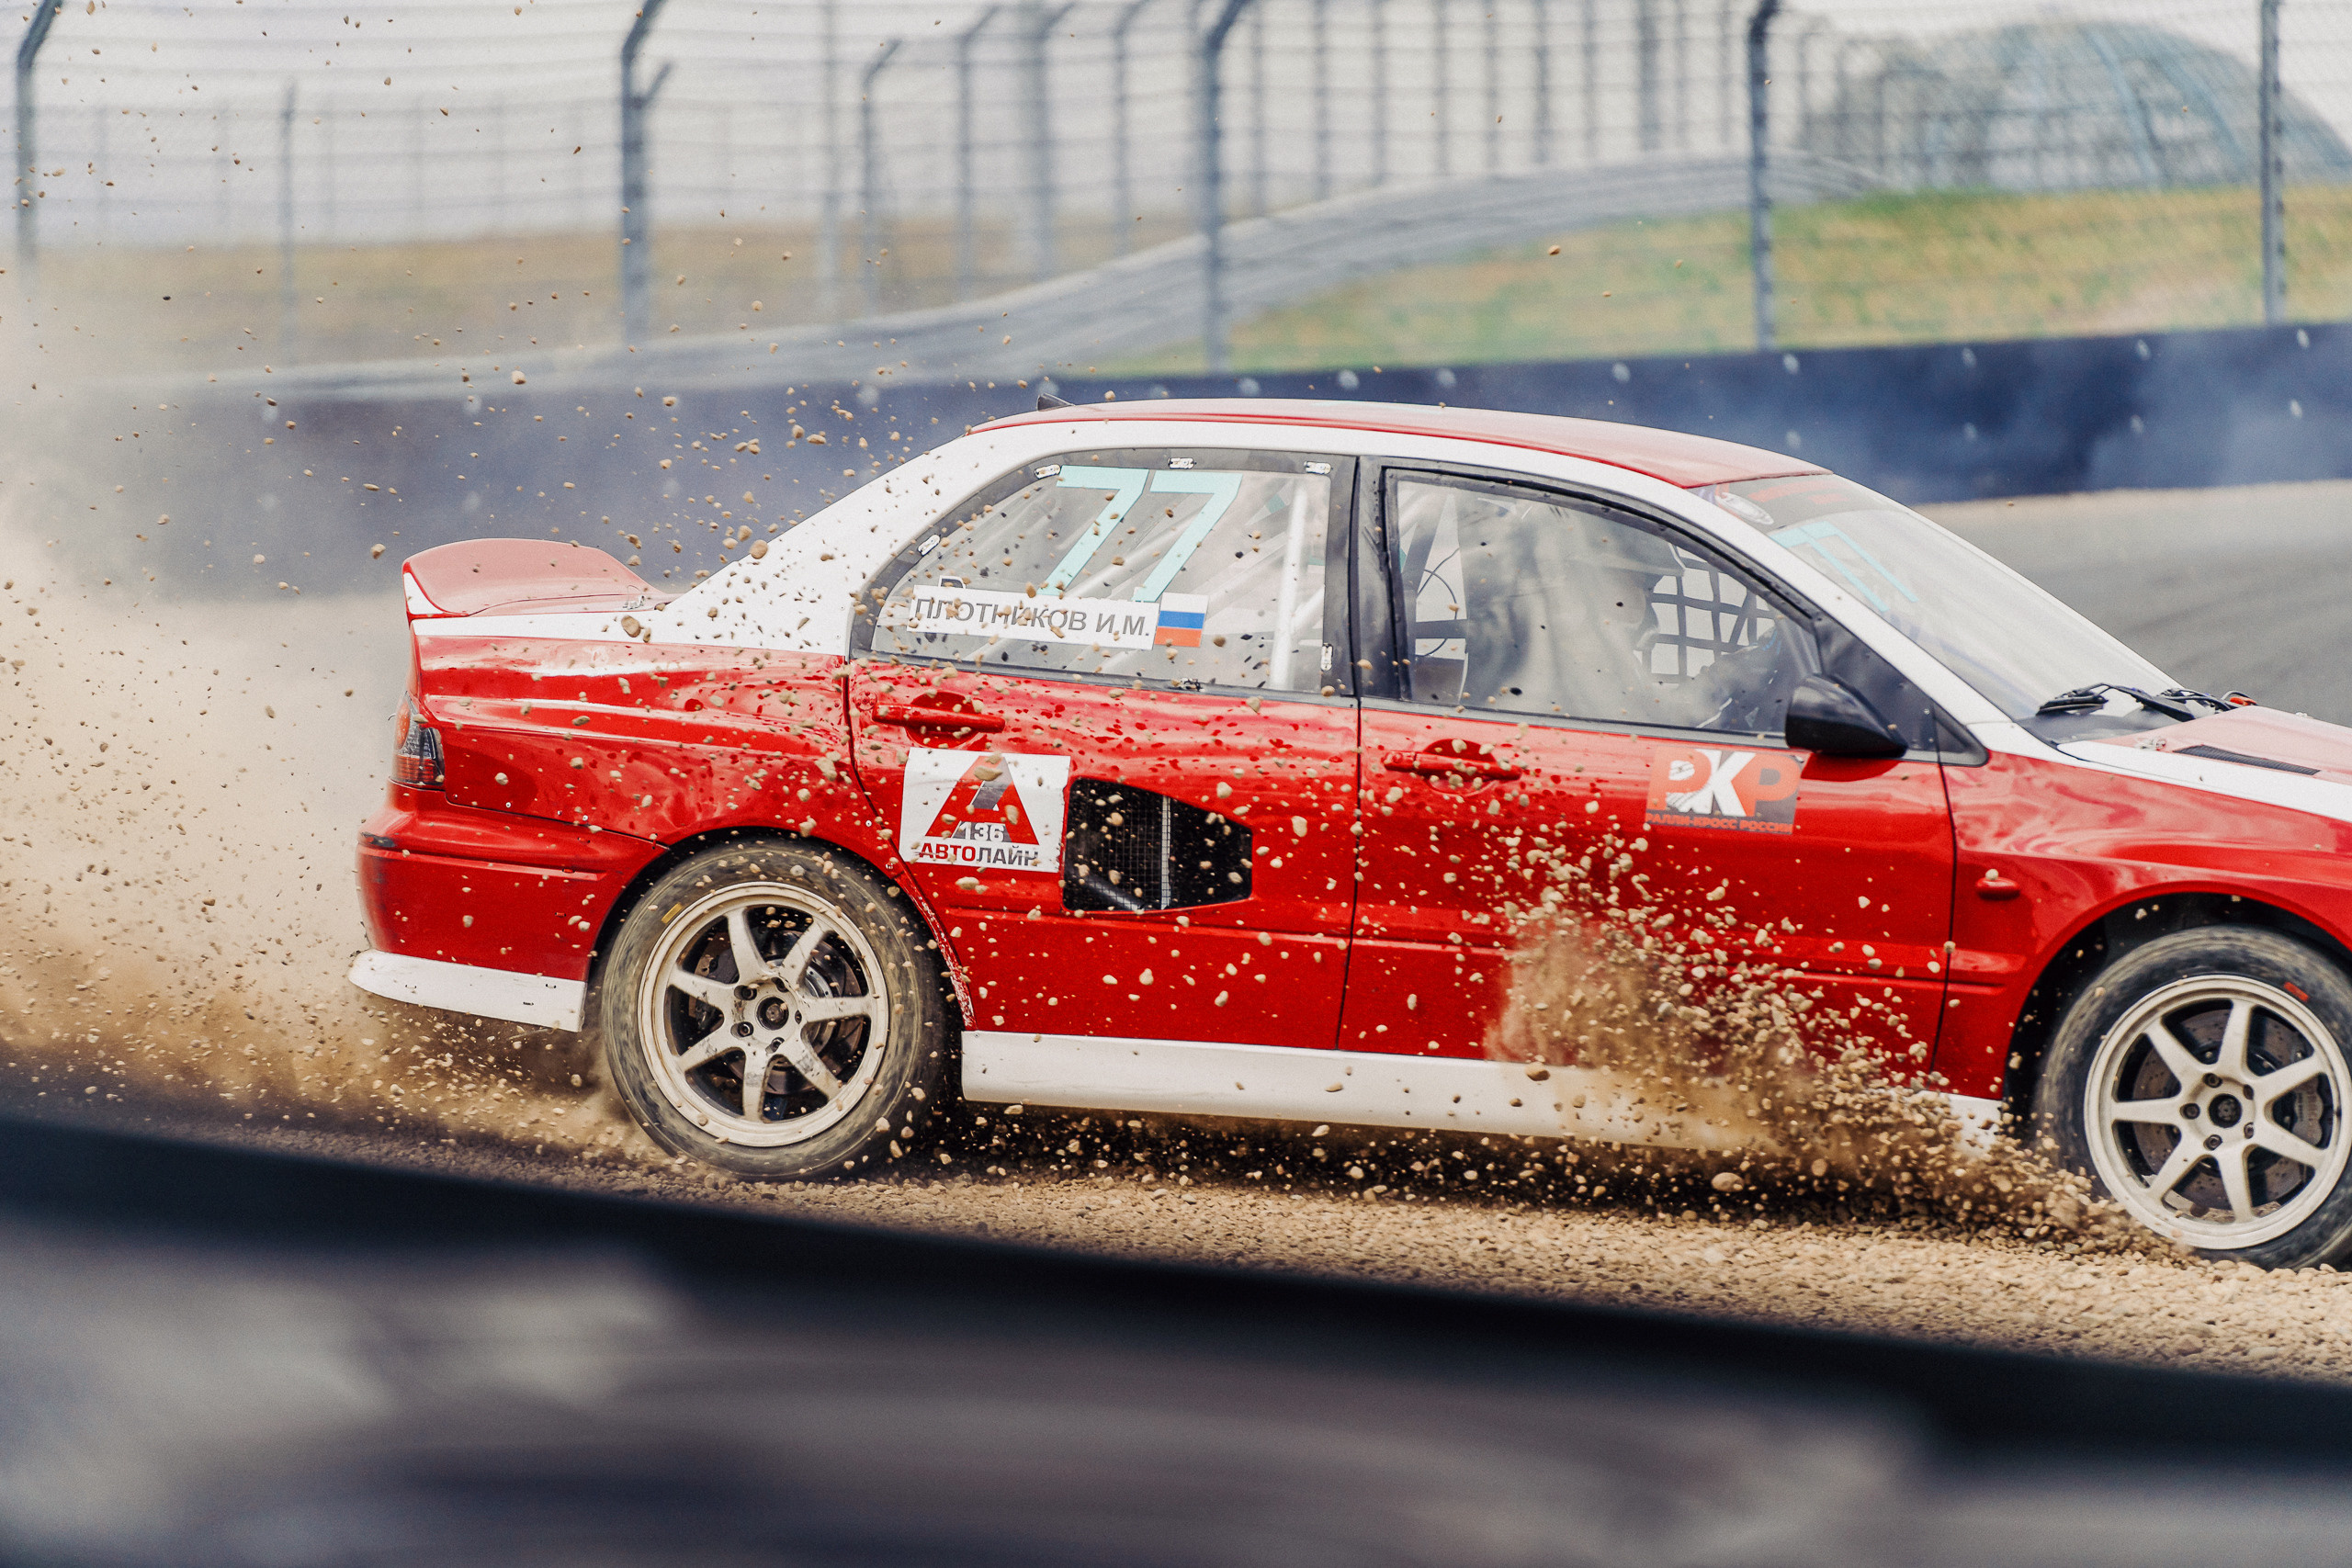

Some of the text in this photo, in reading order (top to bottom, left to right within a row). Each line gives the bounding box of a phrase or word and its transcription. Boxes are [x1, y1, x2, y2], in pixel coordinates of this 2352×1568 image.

[1035, 464, 1243, 602] 77
[915, 598, 1087, 631] ПЛОТНИКОВ
[957, 821, 1005, 843] 136
[919, 842, 1038, 867] АВТОЛАЙН
